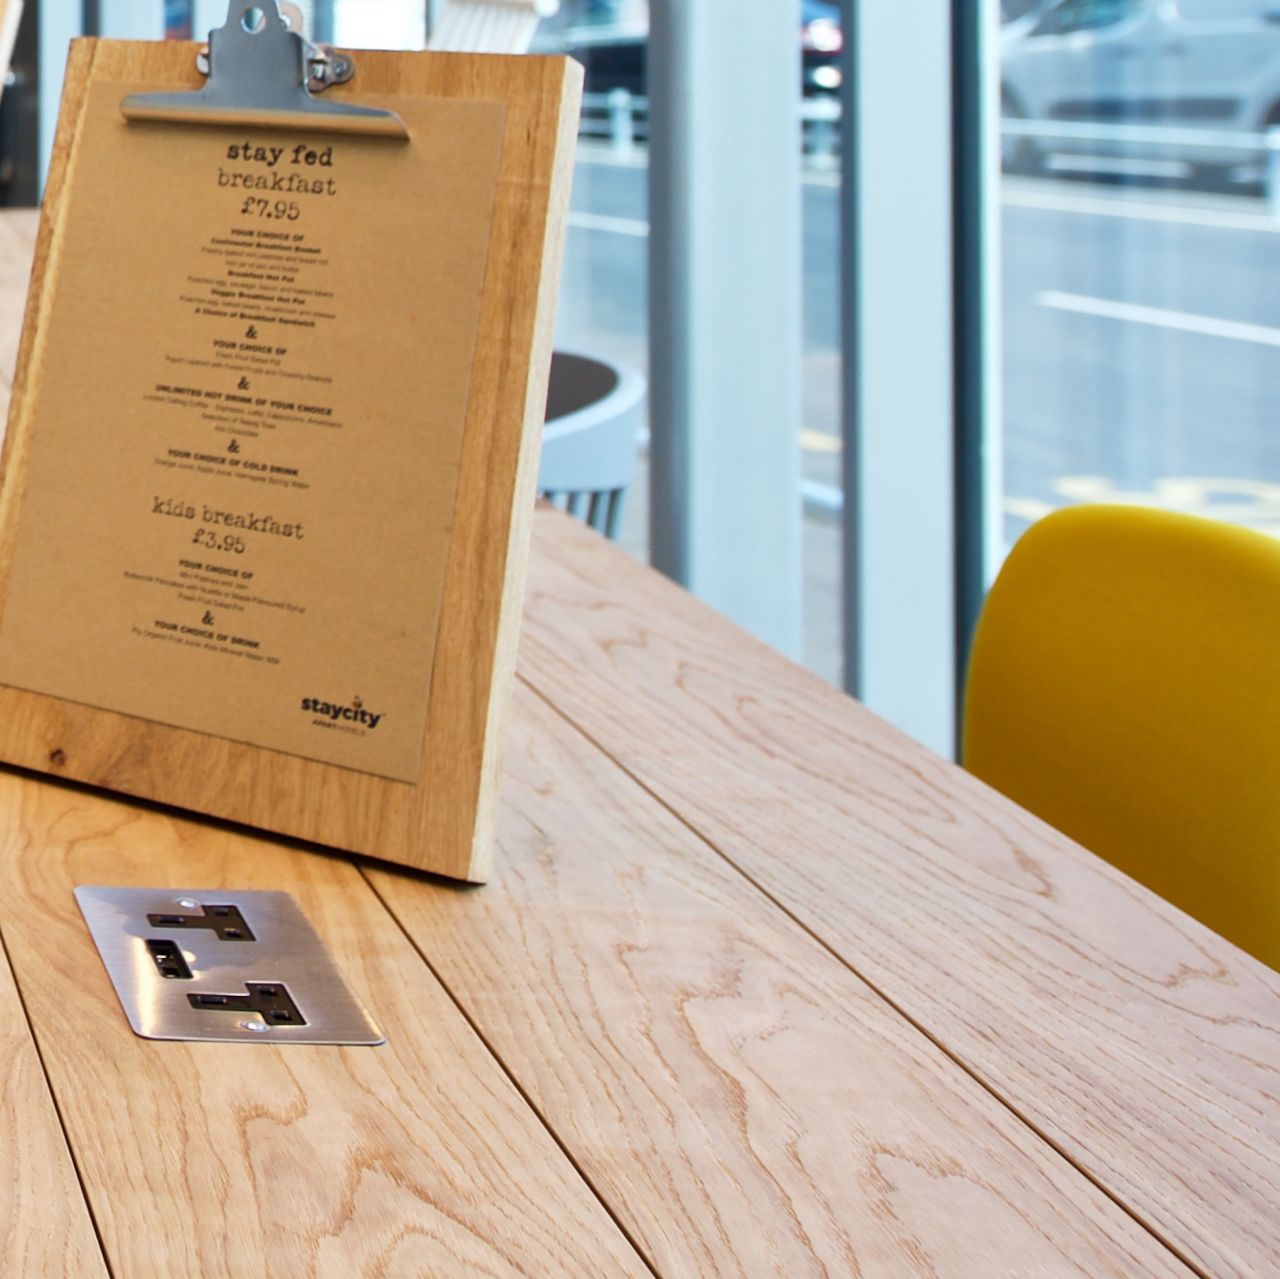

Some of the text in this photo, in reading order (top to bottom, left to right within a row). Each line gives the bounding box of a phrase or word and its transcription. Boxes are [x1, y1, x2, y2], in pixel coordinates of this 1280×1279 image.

[227, 144, 332, 166] stay fed
[219, 169, 335, 195] breakfast
[241, 197, 299, 220] £7.95
[245, 325, 257, 339] &
[213, 340, 236, 349] YOUR
[239, 344, 272, 354] CHOICE
[238, 376, 249, 390] &
[156, 385, 332, 416] UNLIMITED HOT DRINK OF YOUR CHOICE
[228, 439, 239, 453] &
[168, 449, 191, 458] YOUR
[193, 453, 225, 464] CHOICE
[243, 461, 268, 471] COLD
[270, 466, 298, 476] DRINK
[153, 497, 302, 538] kids breakfast
[193, 529, 245, 553] £3.95
[179, 560, 253, 579] YOUR CHOICE OF
[202, 611, 213, 625] &
[155, 621, 178, 631] YOUR
[180, 626, 214, 639] CHOICE
[231, 637, 259, 648] DRINK
[302, 699, 380, 728] staycity
